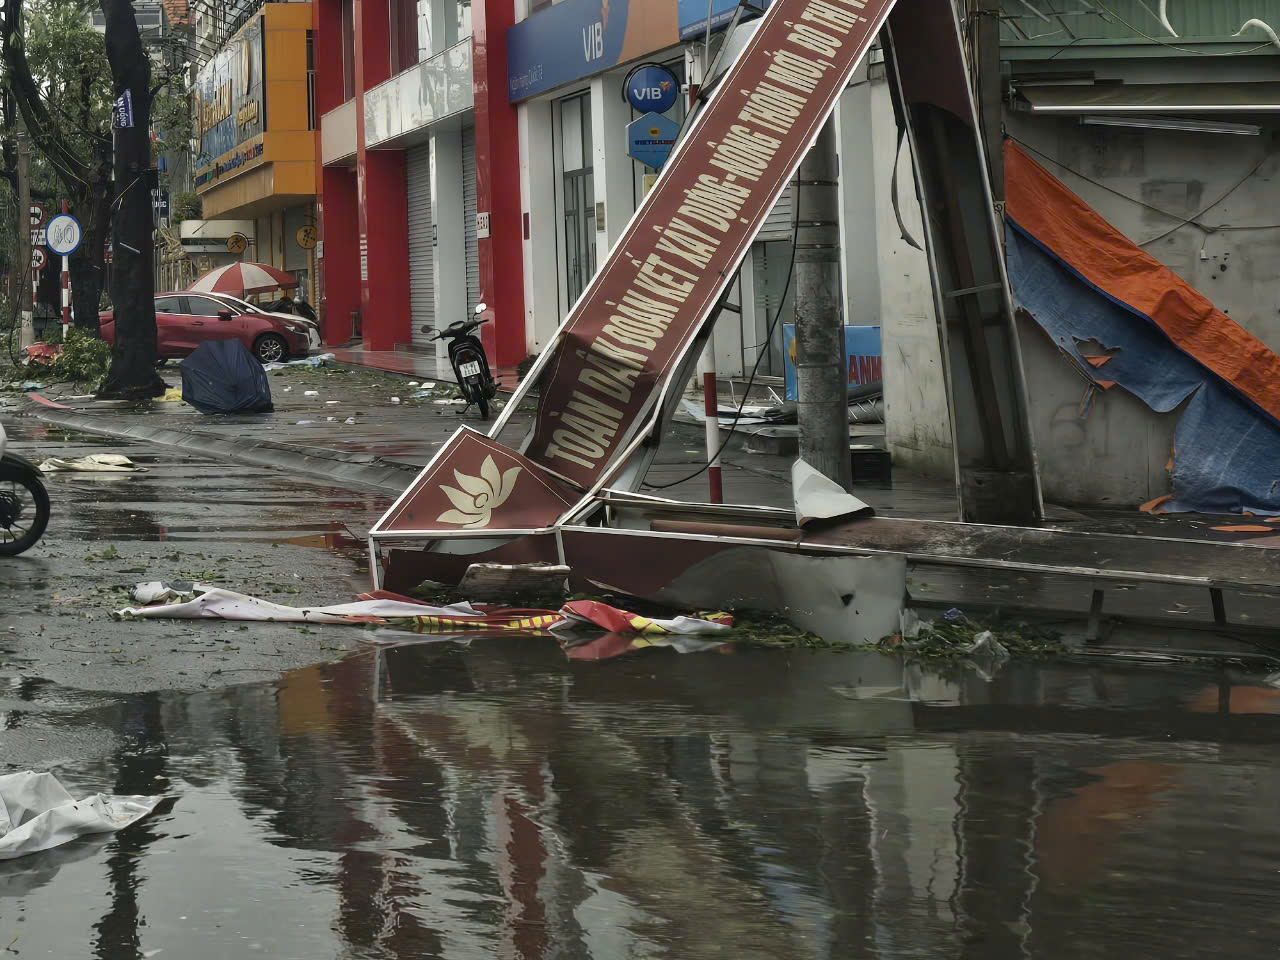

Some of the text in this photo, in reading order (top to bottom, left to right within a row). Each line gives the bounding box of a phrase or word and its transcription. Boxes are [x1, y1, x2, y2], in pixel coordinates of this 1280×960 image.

[582, 22, 604, 63] VIB
[633, 87, 663, 101] VIB
[764, 48, 837, 94] MỚI,
[738, 81, 808, 135] THÔN
[652, 216, 722, 270] XÂY
[624, 251, 700, 308] KẾT
[601, 288, 680, 352] ĐOÀN
[575, 336, 649, 405] DÂN
[848, 354, 883, 385] ANK
[544, 391, 625, 470] TOÀN
